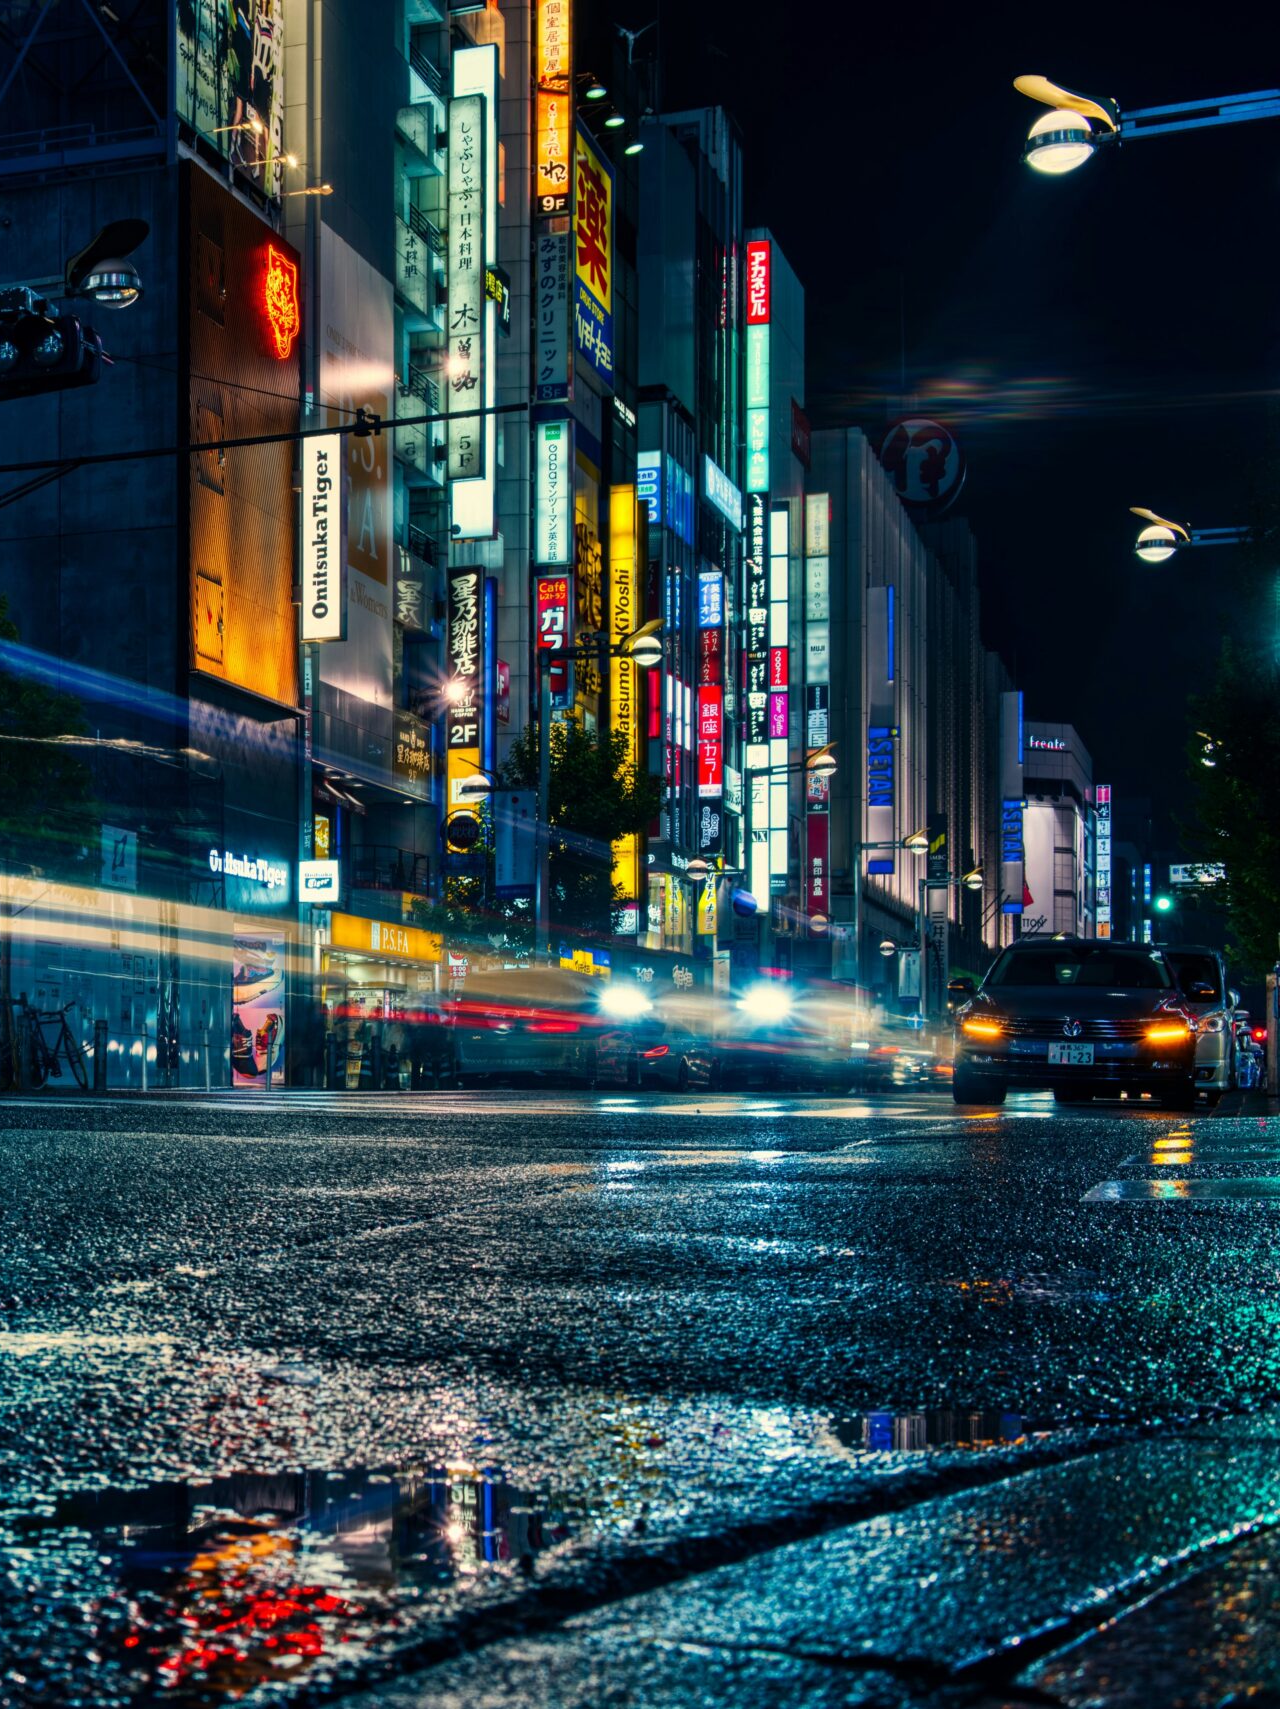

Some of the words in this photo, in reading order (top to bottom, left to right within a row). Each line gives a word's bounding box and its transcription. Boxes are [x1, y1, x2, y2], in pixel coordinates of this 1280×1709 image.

[545, 2, 560, 72] 個室居酒屋
[542, 197, 565, 211] 9F
[751, 251, 766, 317] アカネビル
[540, 238, 556, 381] みずのクリニック
[542, 385, 561, 399] 8F
[539, 582, 566, 593] Café
[450, 573, 477, 680] 星乃珈琲店
[810, 644, 826, 652] MUJI
[451, 725, 477, 744] 2F
[1030, 735, 1065, 750] frente
[868, 726, 893, 807] ISETAN
[701, 806, 710, 828] Free
[710, 813, 720, 838] Shop
[701, 827, 710, 848] Tax
[1002, 800, 1024, 862] ISETAN
[813, 858, 823, 896] 無印良品
[382, 927, 409, 953] P.S.FA
[1060, 1051, 1091, 1064] 11-23
